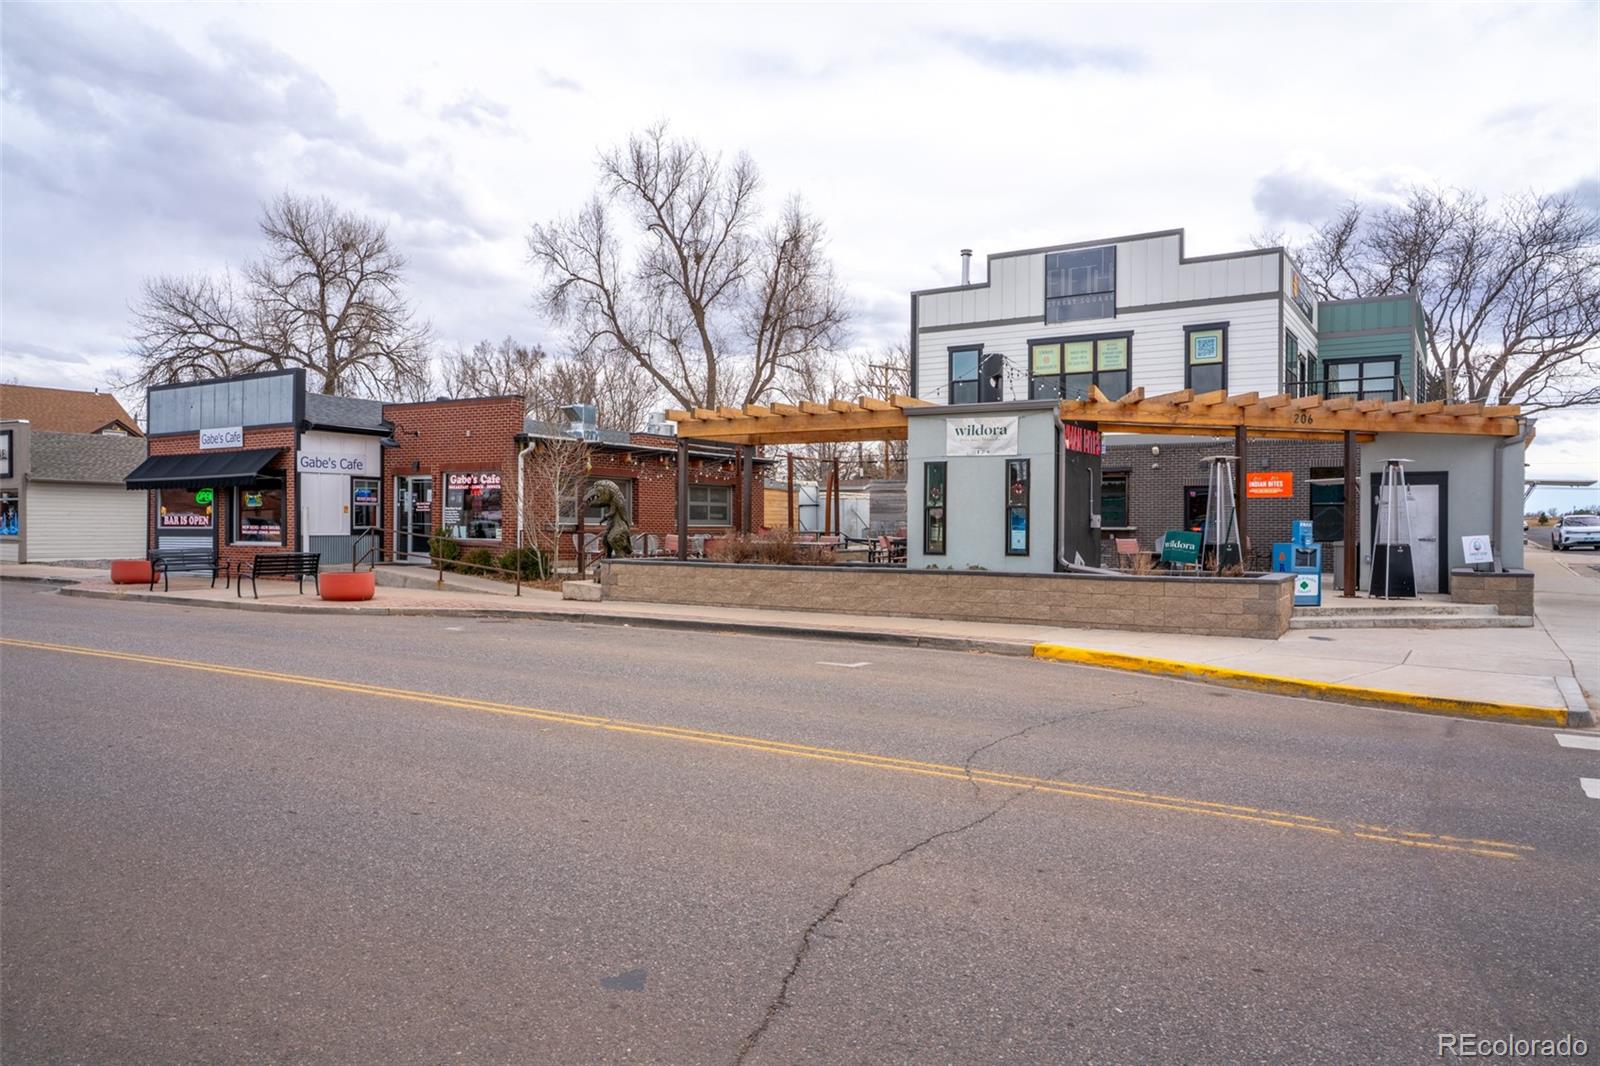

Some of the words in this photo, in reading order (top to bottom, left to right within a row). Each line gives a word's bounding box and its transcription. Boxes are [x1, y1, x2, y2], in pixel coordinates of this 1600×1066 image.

[1294, 413, 1314, 424] 206
[955, 424, 1008, 437] wildora
[201, 432, 224, 445] Gabe's
[225, 431, 241, 444] Cafe
[300, 456, 337, 469] Gabe's
[340, 457, 363, 470] Cafe
[450, 474, 478, 484] Gabe's
[480, 474, 500, 484] Cafe
[164, 515, 179, 525] BAR
[180, 515, 187, 525] IS
[189, 515, 209, 525] OPEN
